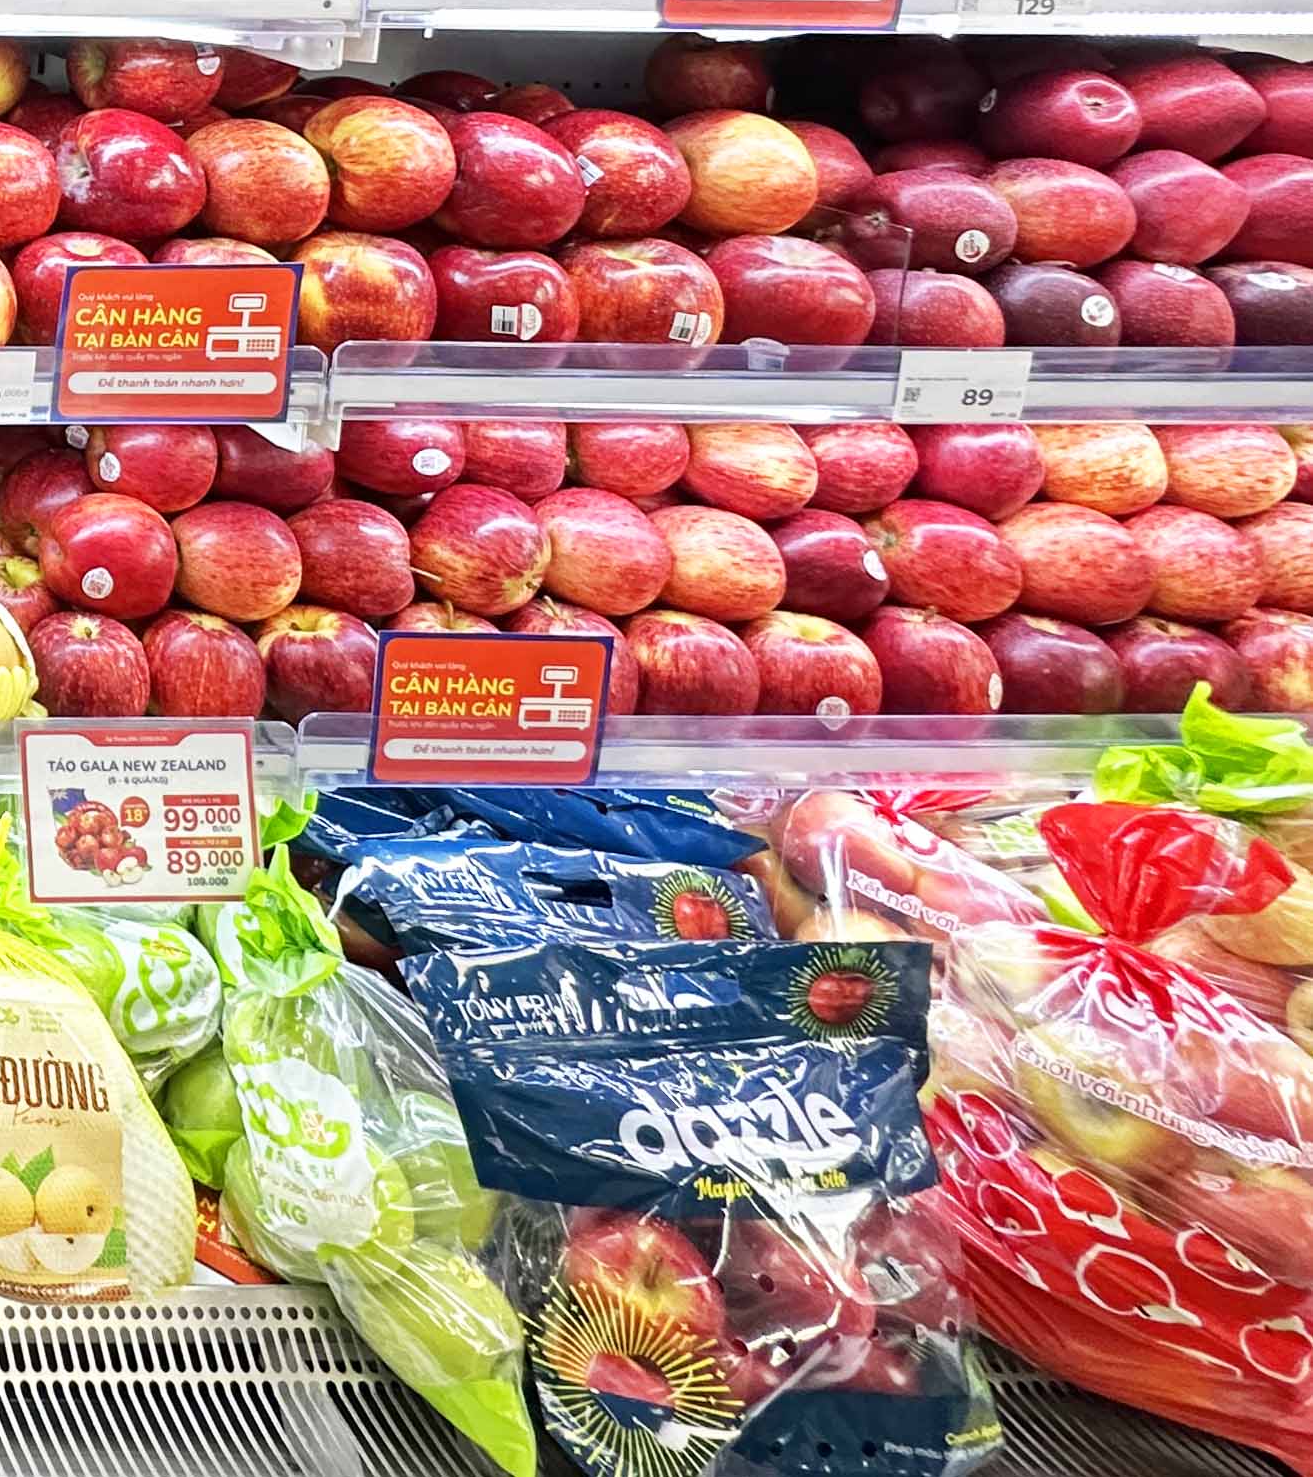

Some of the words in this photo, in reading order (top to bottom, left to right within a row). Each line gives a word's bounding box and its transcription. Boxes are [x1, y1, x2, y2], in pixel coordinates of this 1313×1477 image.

[74, 302, 126, 326] CÂN
[133, 303, 203, 326] HÀNG
[74, 332, 106, 352] TẠI
[110, 329, 152, 347] BÀN
[157, 329, 200, 348] CÂN
[962, 389, 993, 406] 89
[390, 672, 440, 694] CÂN
[446, 673, 515, 695] HÀNG
[390, 701, 420, 718] TẠI
[425, 698, 467, 716] BÀN
[471, 699, 512, 717] CÂN
[47, 757, 76, 773] TÁO
[81, 760, 119, 773] GALA
[123, 759, 157, 773] NEW
[161, 759, 227, 772] ZEALAND
[164, 808, 241, 832] 99.000
[167, 850, 244, 874] 89.000
[187, 875, 229, 886] 109.000
[619, 1069, 862, 1173] dazzle
